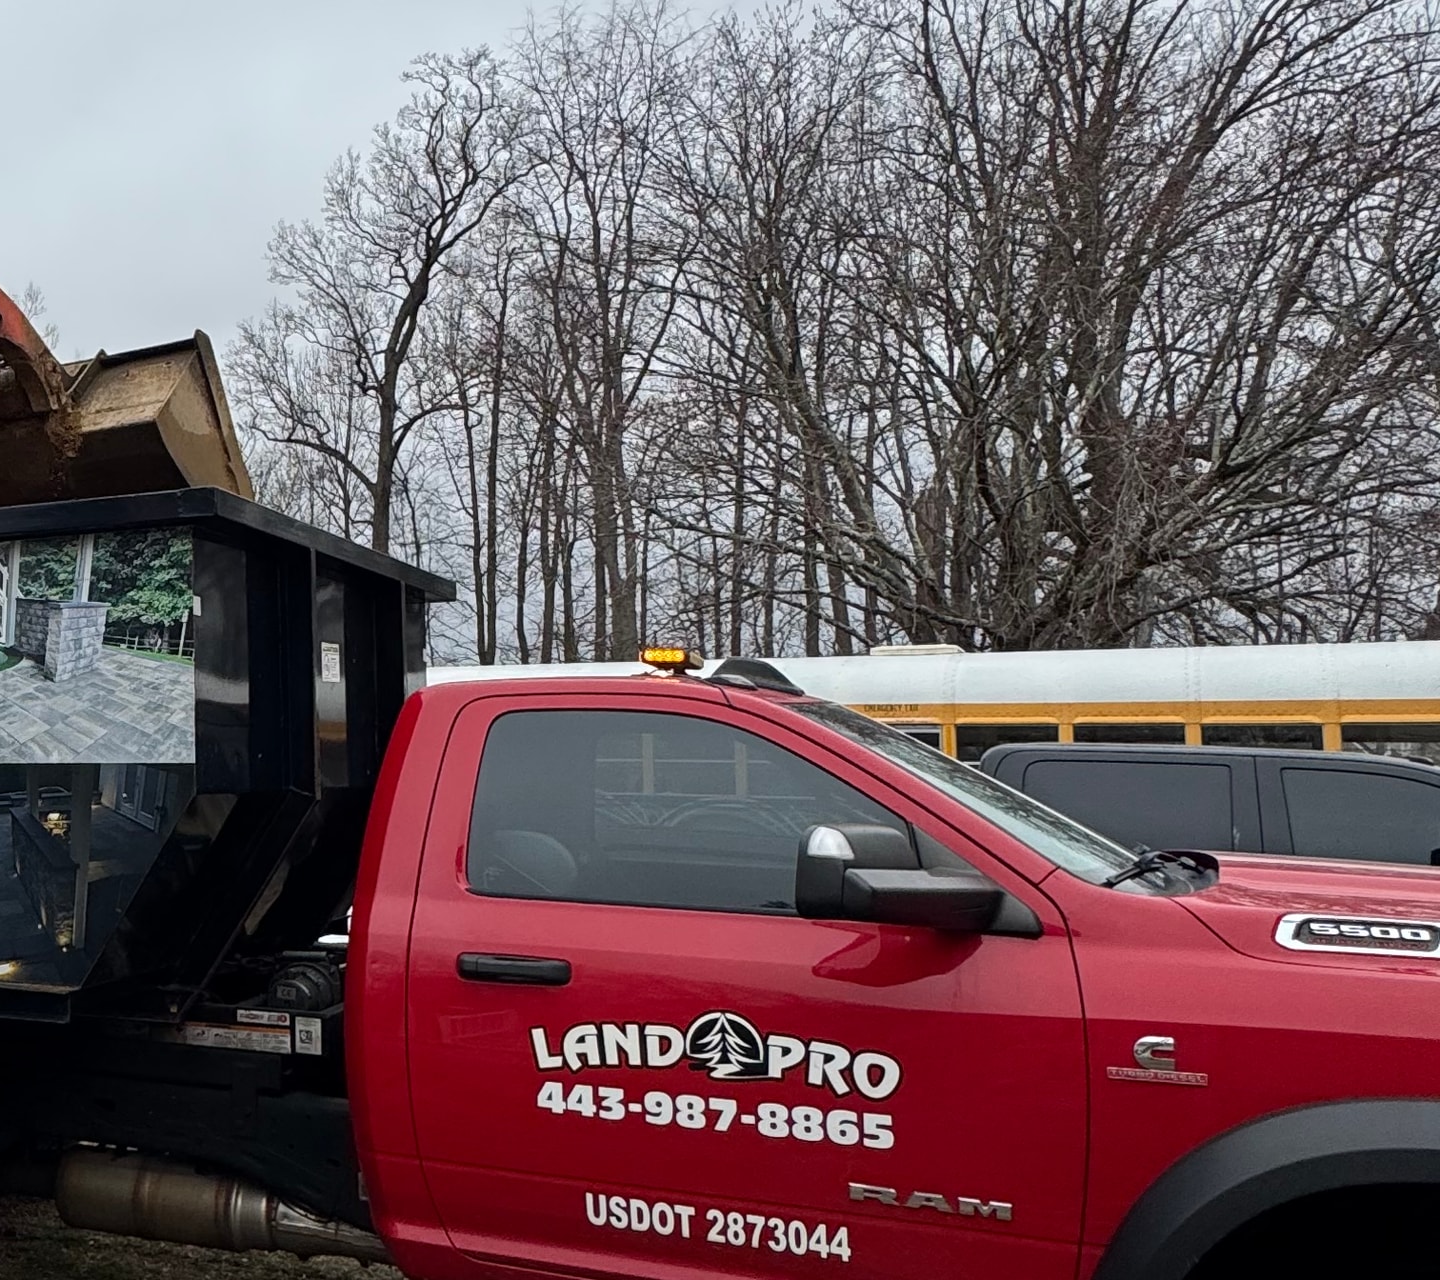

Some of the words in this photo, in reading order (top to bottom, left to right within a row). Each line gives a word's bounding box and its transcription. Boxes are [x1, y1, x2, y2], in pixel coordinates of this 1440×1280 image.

[1309, 922, 1432, 941] 5500
[530, 1023, 685, 1072] LAND
[766, 1034, 901, 1100] PRO
[536, 1081, 895, 1150] 443-987-8865
[585, 1191, 696, 1239] USDOT
[706, 1208, 852, 1263] 2873044
[848, 1181, 1013, 1220] RAM
